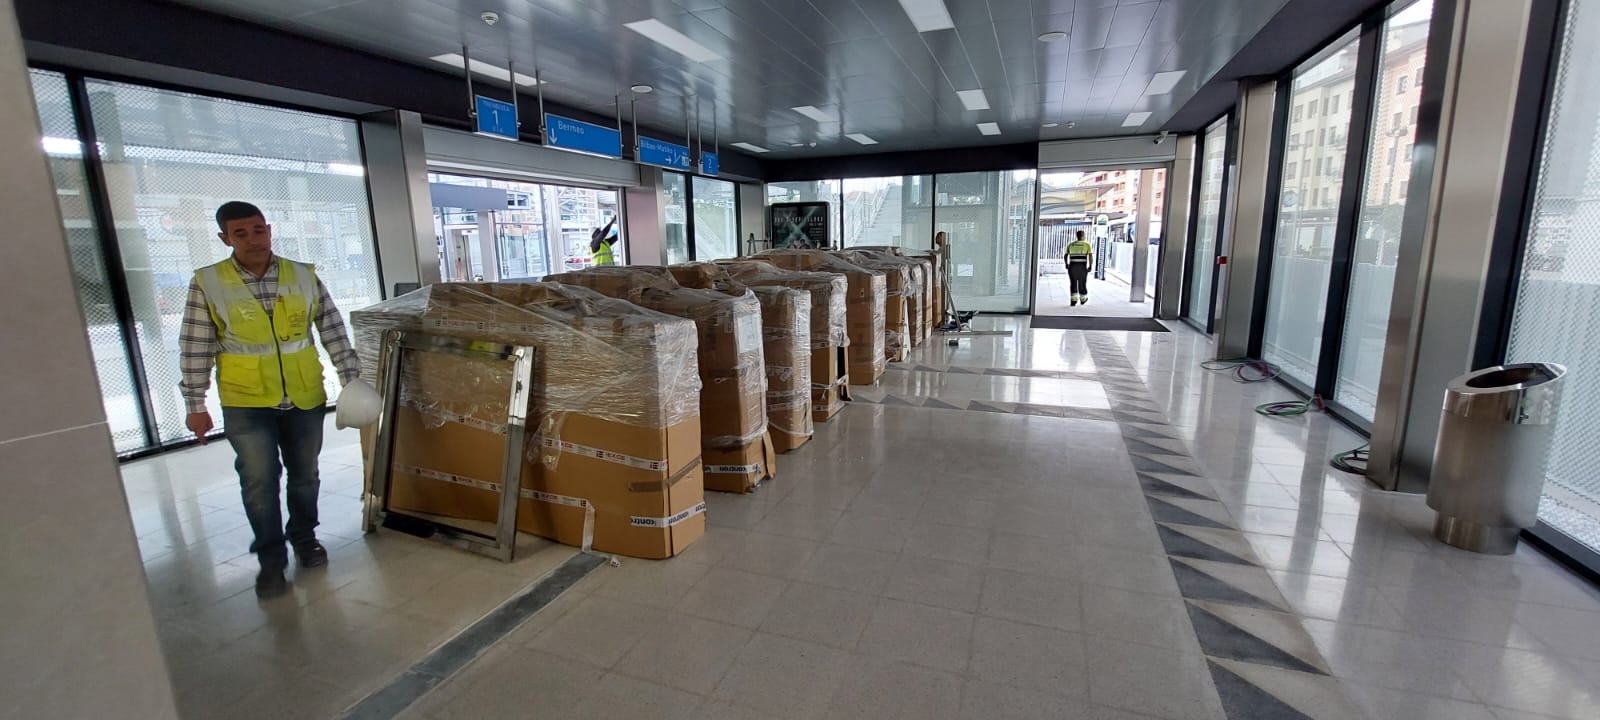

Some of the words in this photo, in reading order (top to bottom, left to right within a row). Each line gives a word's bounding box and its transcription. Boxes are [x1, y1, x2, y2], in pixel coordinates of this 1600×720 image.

[492, 110, 499, 125] 1
[558, 120, 585, 135] Bermeo
[708, 158, 713, 169] 2
